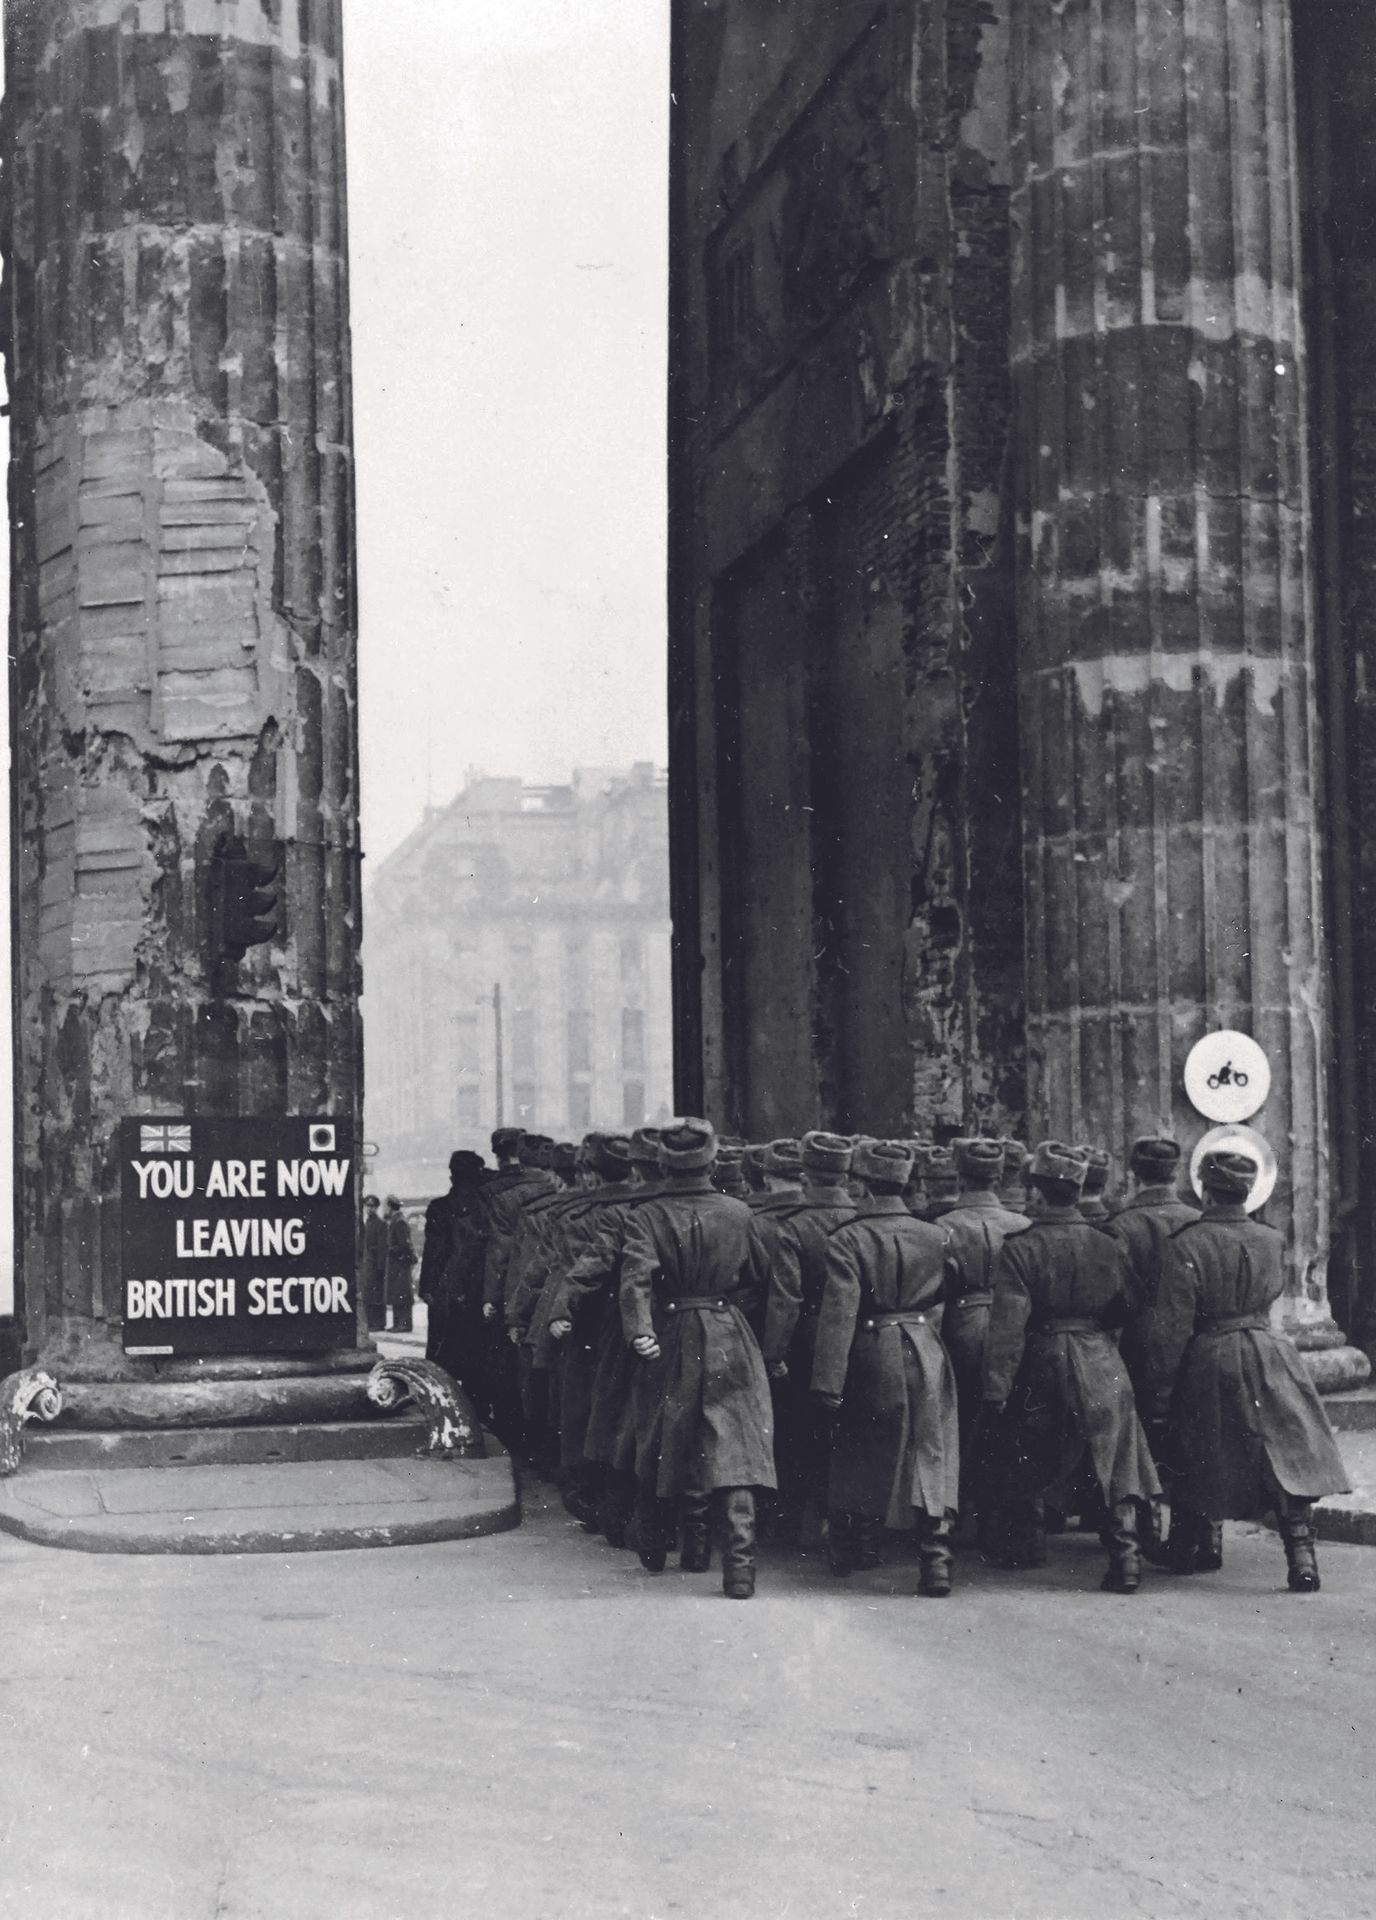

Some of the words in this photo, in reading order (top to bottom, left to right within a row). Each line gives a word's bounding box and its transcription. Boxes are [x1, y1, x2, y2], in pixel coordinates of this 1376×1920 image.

[131, 1160, 194, 1199] YOU
[205, 1160, 266, 1198] ARE
[277, 1159, 349, 1197] NOW
[176, 1218, 306, 1258] LEAVING
[127, 1279, 235, 1319] BRITISH
[248, 1277, 352, 1315] SECTOR
